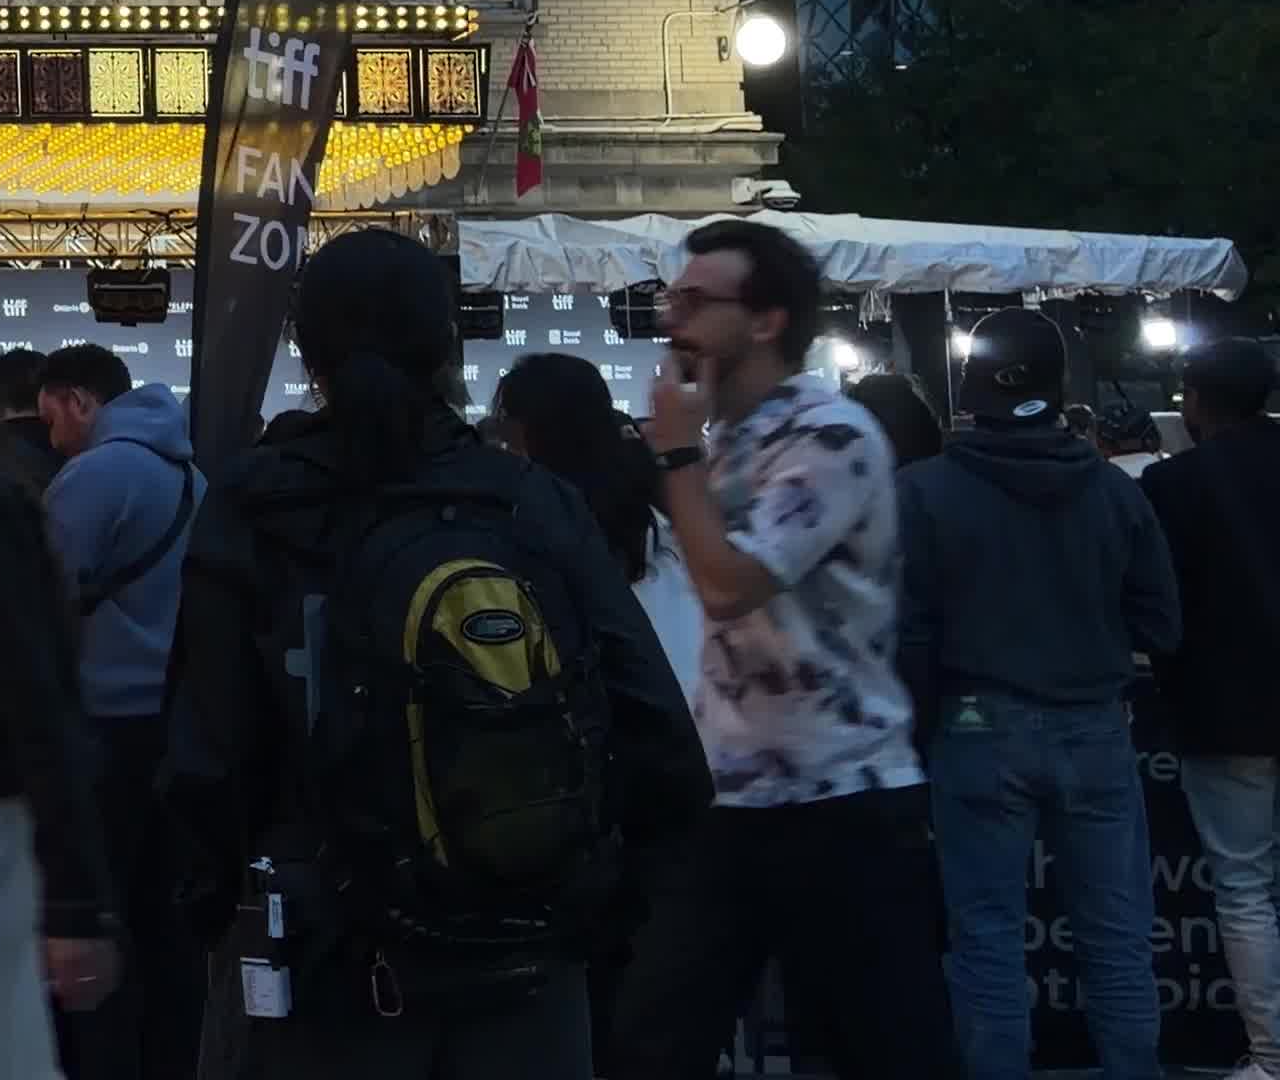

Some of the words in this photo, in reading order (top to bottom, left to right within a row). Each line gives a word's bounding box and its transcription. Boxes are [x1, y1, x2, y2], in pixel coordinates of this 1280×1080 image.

[242, 26, 321, 111] tiff
[229, 212, 308, 271] ZO
[2, 298, 28, 317] tiff
[552, 294, 574, 311] tiff
[505, 329, 527, 346] tiff
